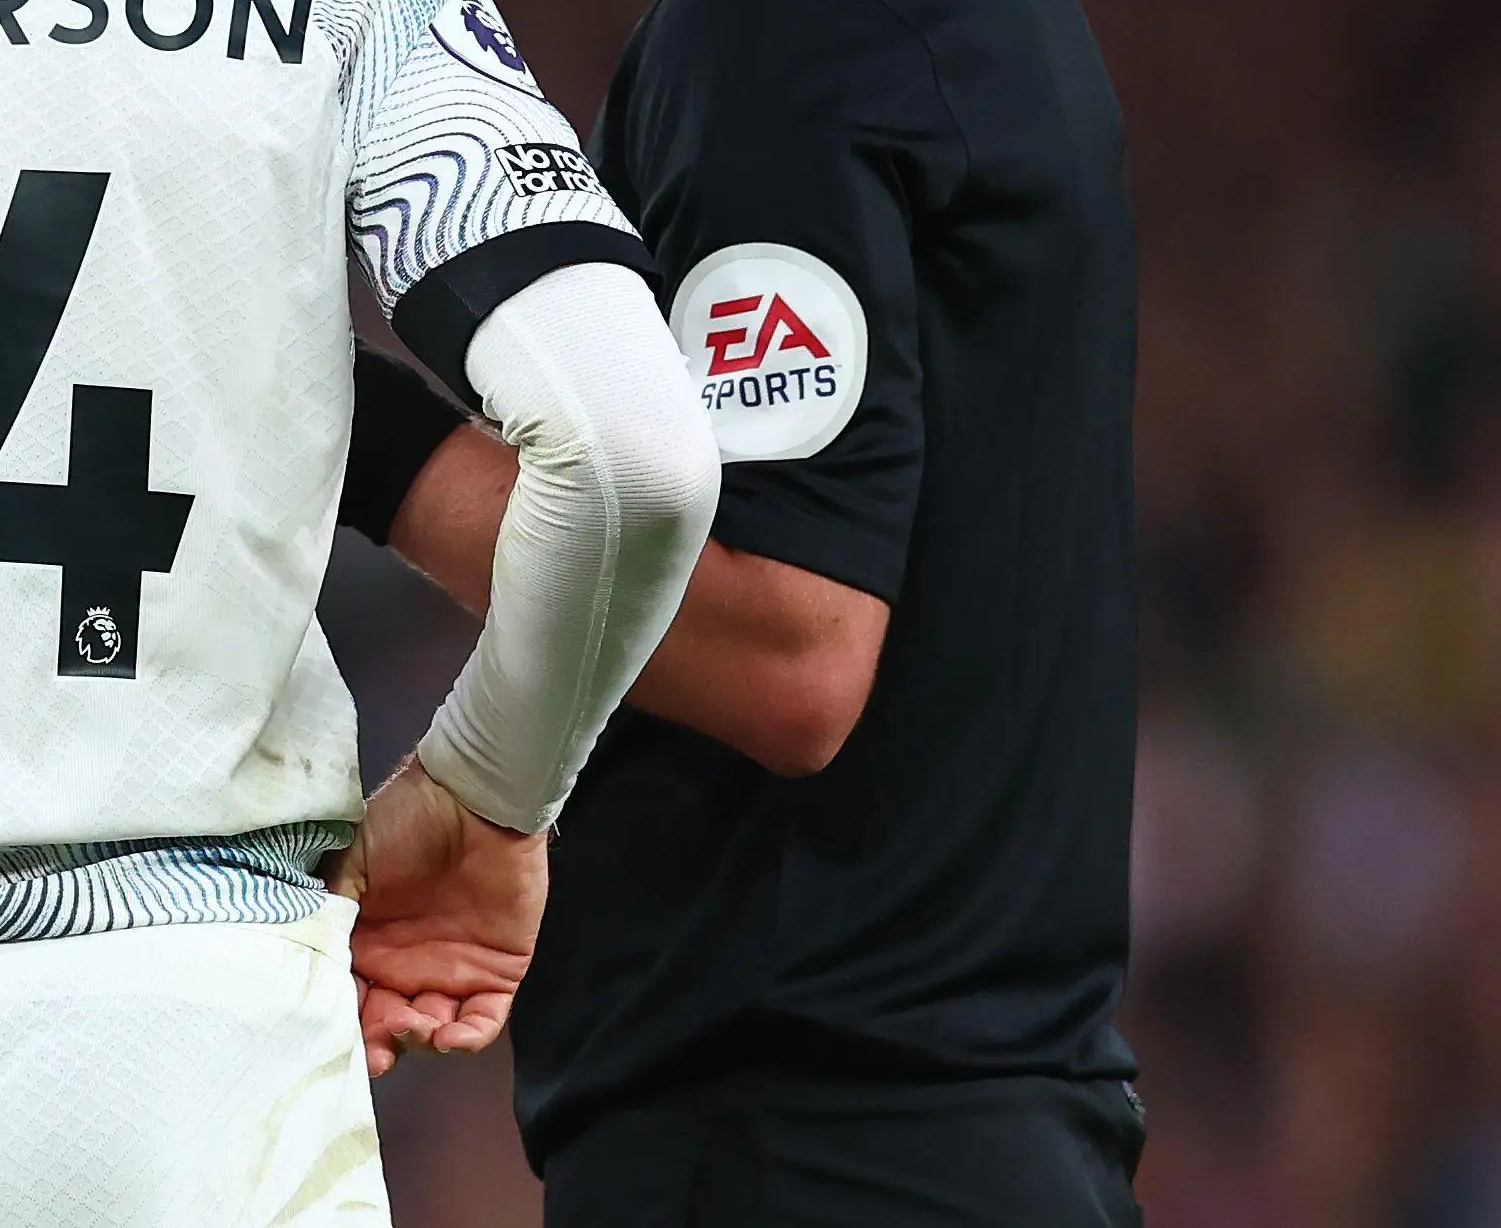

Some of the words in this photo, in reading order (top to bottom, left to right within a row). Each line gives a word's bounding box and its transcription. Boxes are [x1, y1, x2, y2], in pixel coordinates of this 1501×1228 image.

[495, 145, 551, 175] No
[510, 170, 558, 197] For
[705, 292, 832, 376] EA
[701, 364, 837, 410] SPORTS
